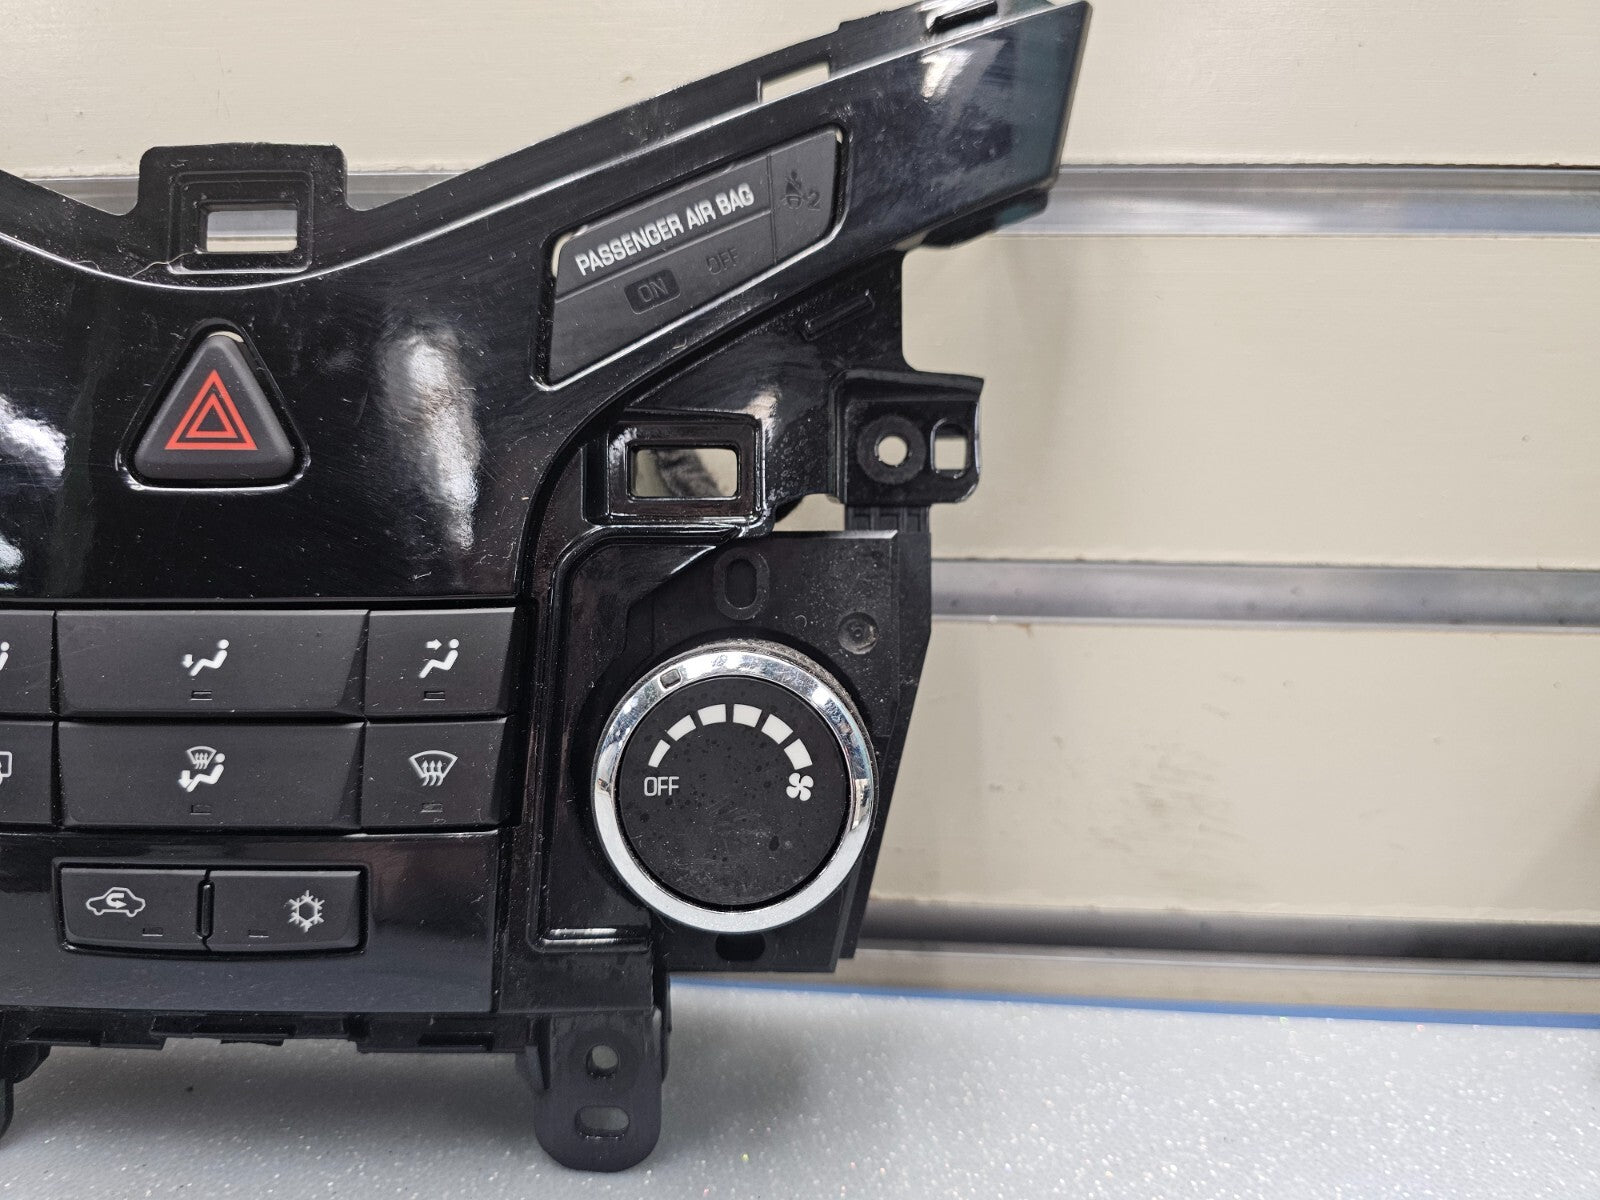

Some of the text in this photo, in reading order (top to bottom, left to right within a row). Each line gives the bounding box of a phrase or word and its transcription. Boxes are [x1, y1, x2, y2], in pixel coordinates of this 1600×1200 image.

[574, 182, 755, 276] PASSENGER AIR BAG
[636, 247, 741, 304] ON OFF
[644, 776, 680, 797] OFF
